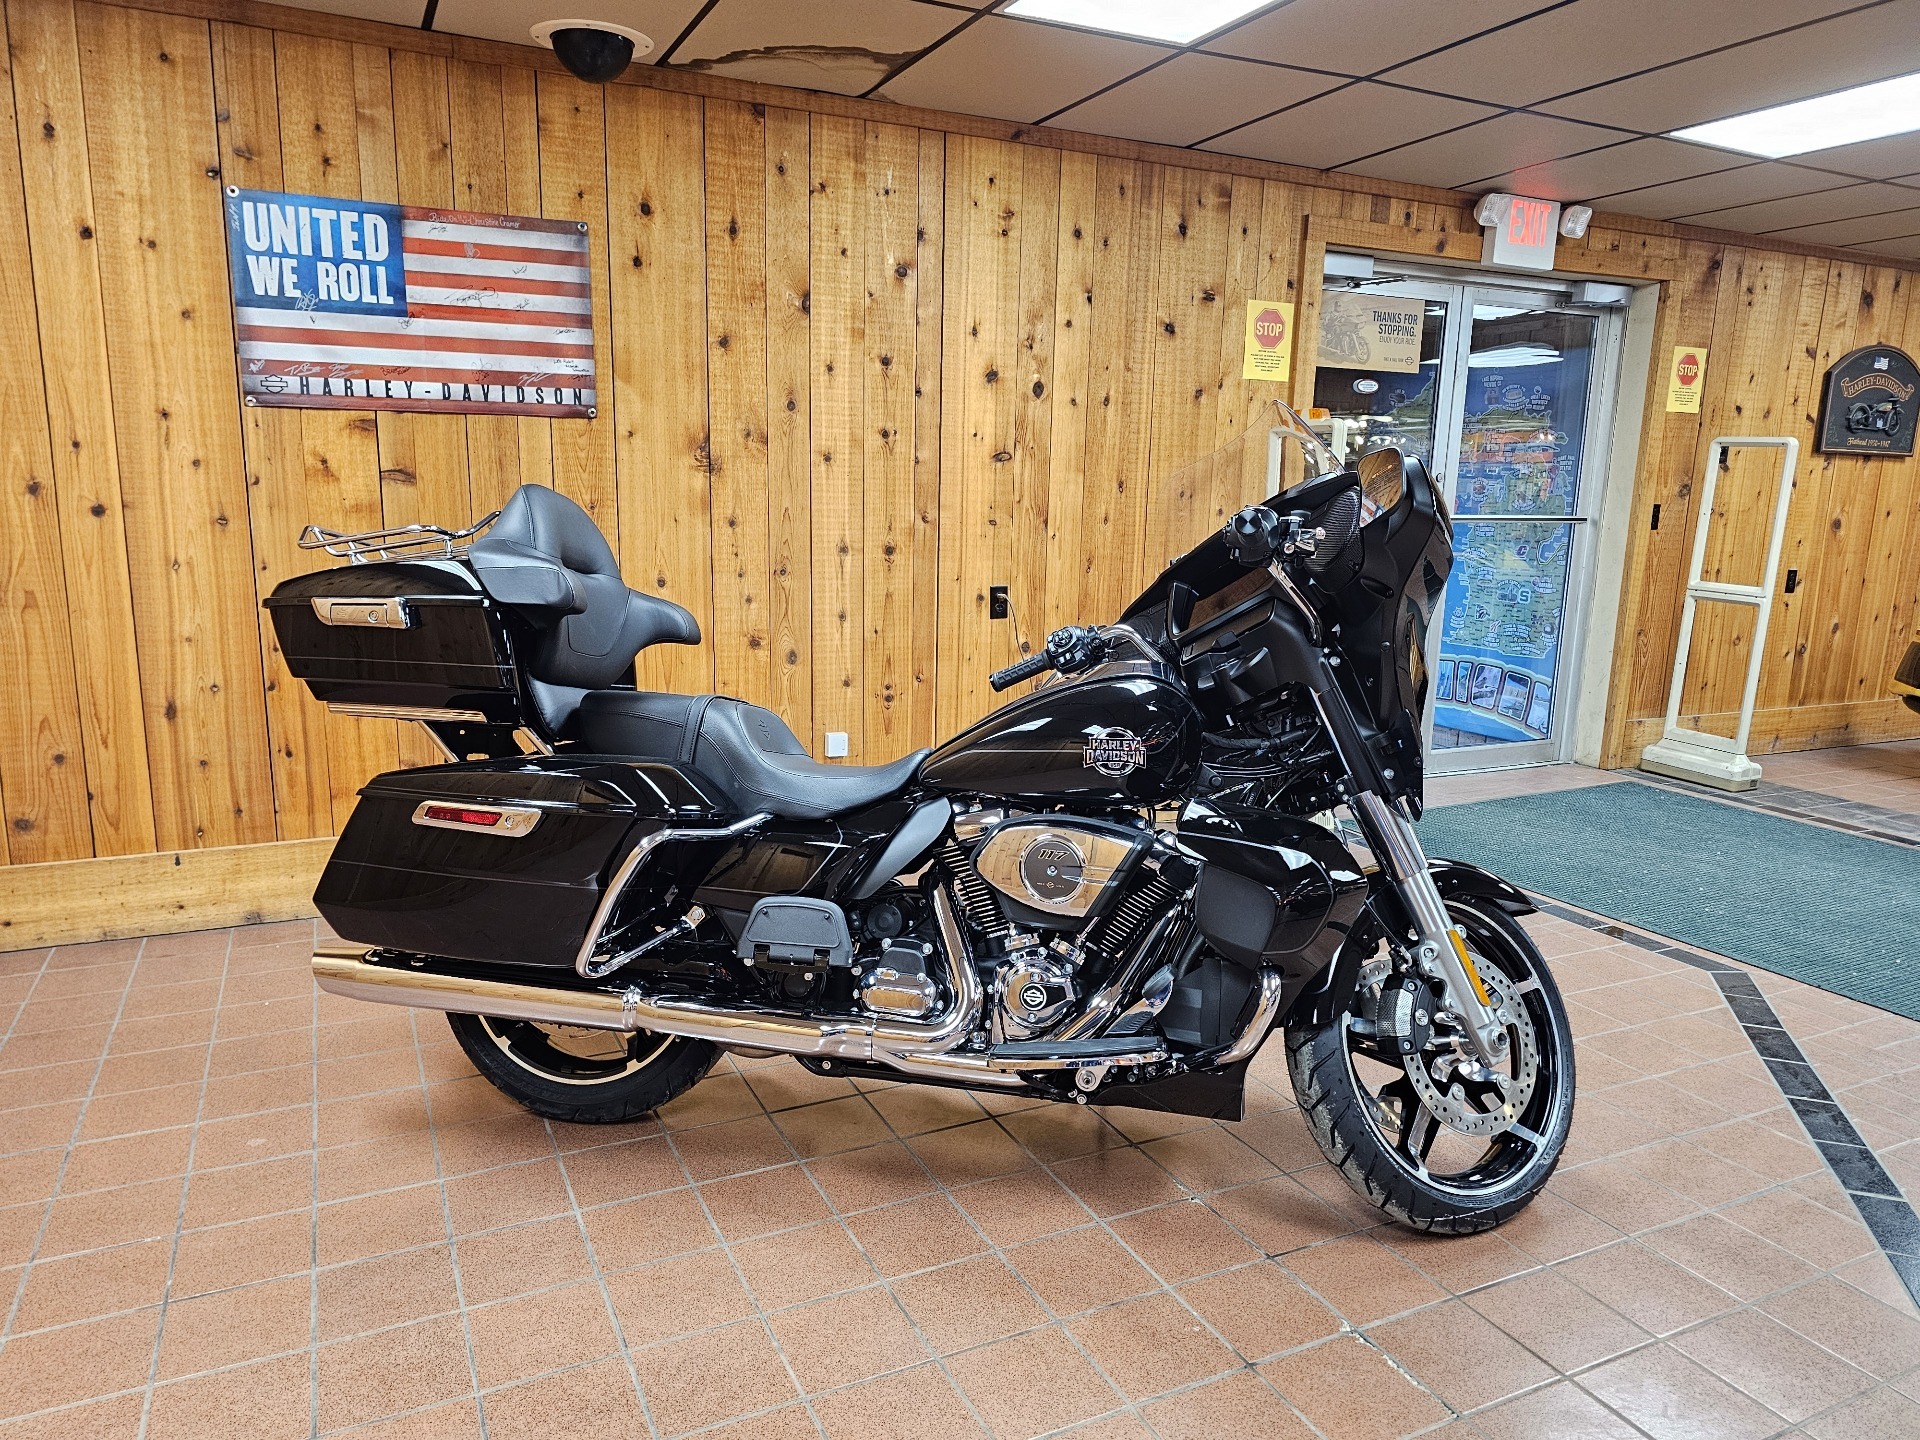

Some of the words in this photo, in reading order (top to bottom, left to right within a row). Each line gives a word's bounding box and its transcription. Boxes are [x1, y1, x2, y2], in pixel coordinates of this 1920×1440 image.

[1508, 199, 1552, 248] EXIT
[242, 201, 389, 262] UNITED
[246, 255, 301, 298] WE
[316, 261, 394, 305] ROLL
[1373, 311, 1402, 324] THANKS
[1404, 314, 1418, 326] FOR
[1256, 321, 1283, 337] STOP
[1378, 323, 1417, 338] STOPPING.
[1393, 336, 1405, 345] YOUR
[1678, 364, 1698, 377] STOP
[300, 376, 582, 406] HARLEY-DAVIDSON
[1848, 376, 1906, 399] HARLEY-DAVIDSON
[1086, 750, 1145, 765] DAVIDSON
[1038, 848, 1070, 861] 117
